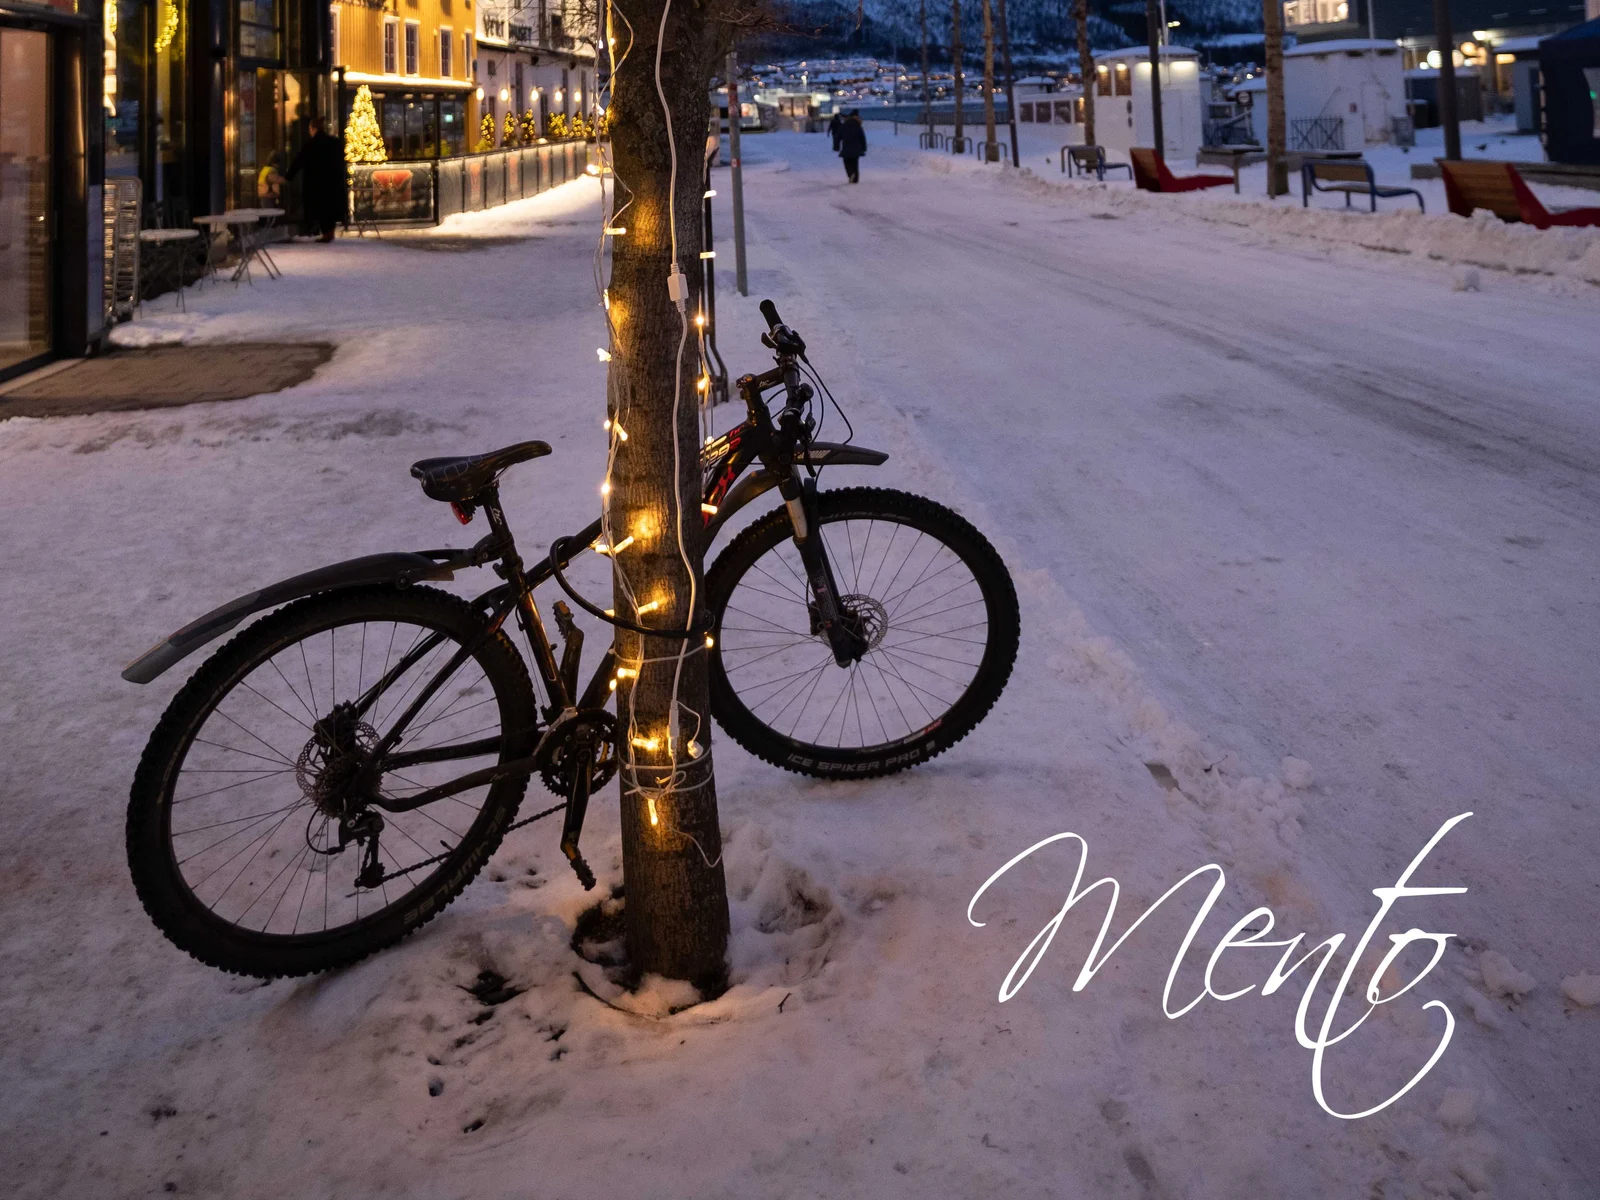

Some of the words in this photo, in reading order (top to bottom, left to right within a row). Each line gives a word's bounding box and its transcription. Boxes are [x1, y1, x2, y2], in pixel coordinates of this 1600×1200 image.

[787, 753, 815, 767] ICE
[816, 760, 881, 772] SPIKER
[885, 749, 920, 767] PRO
